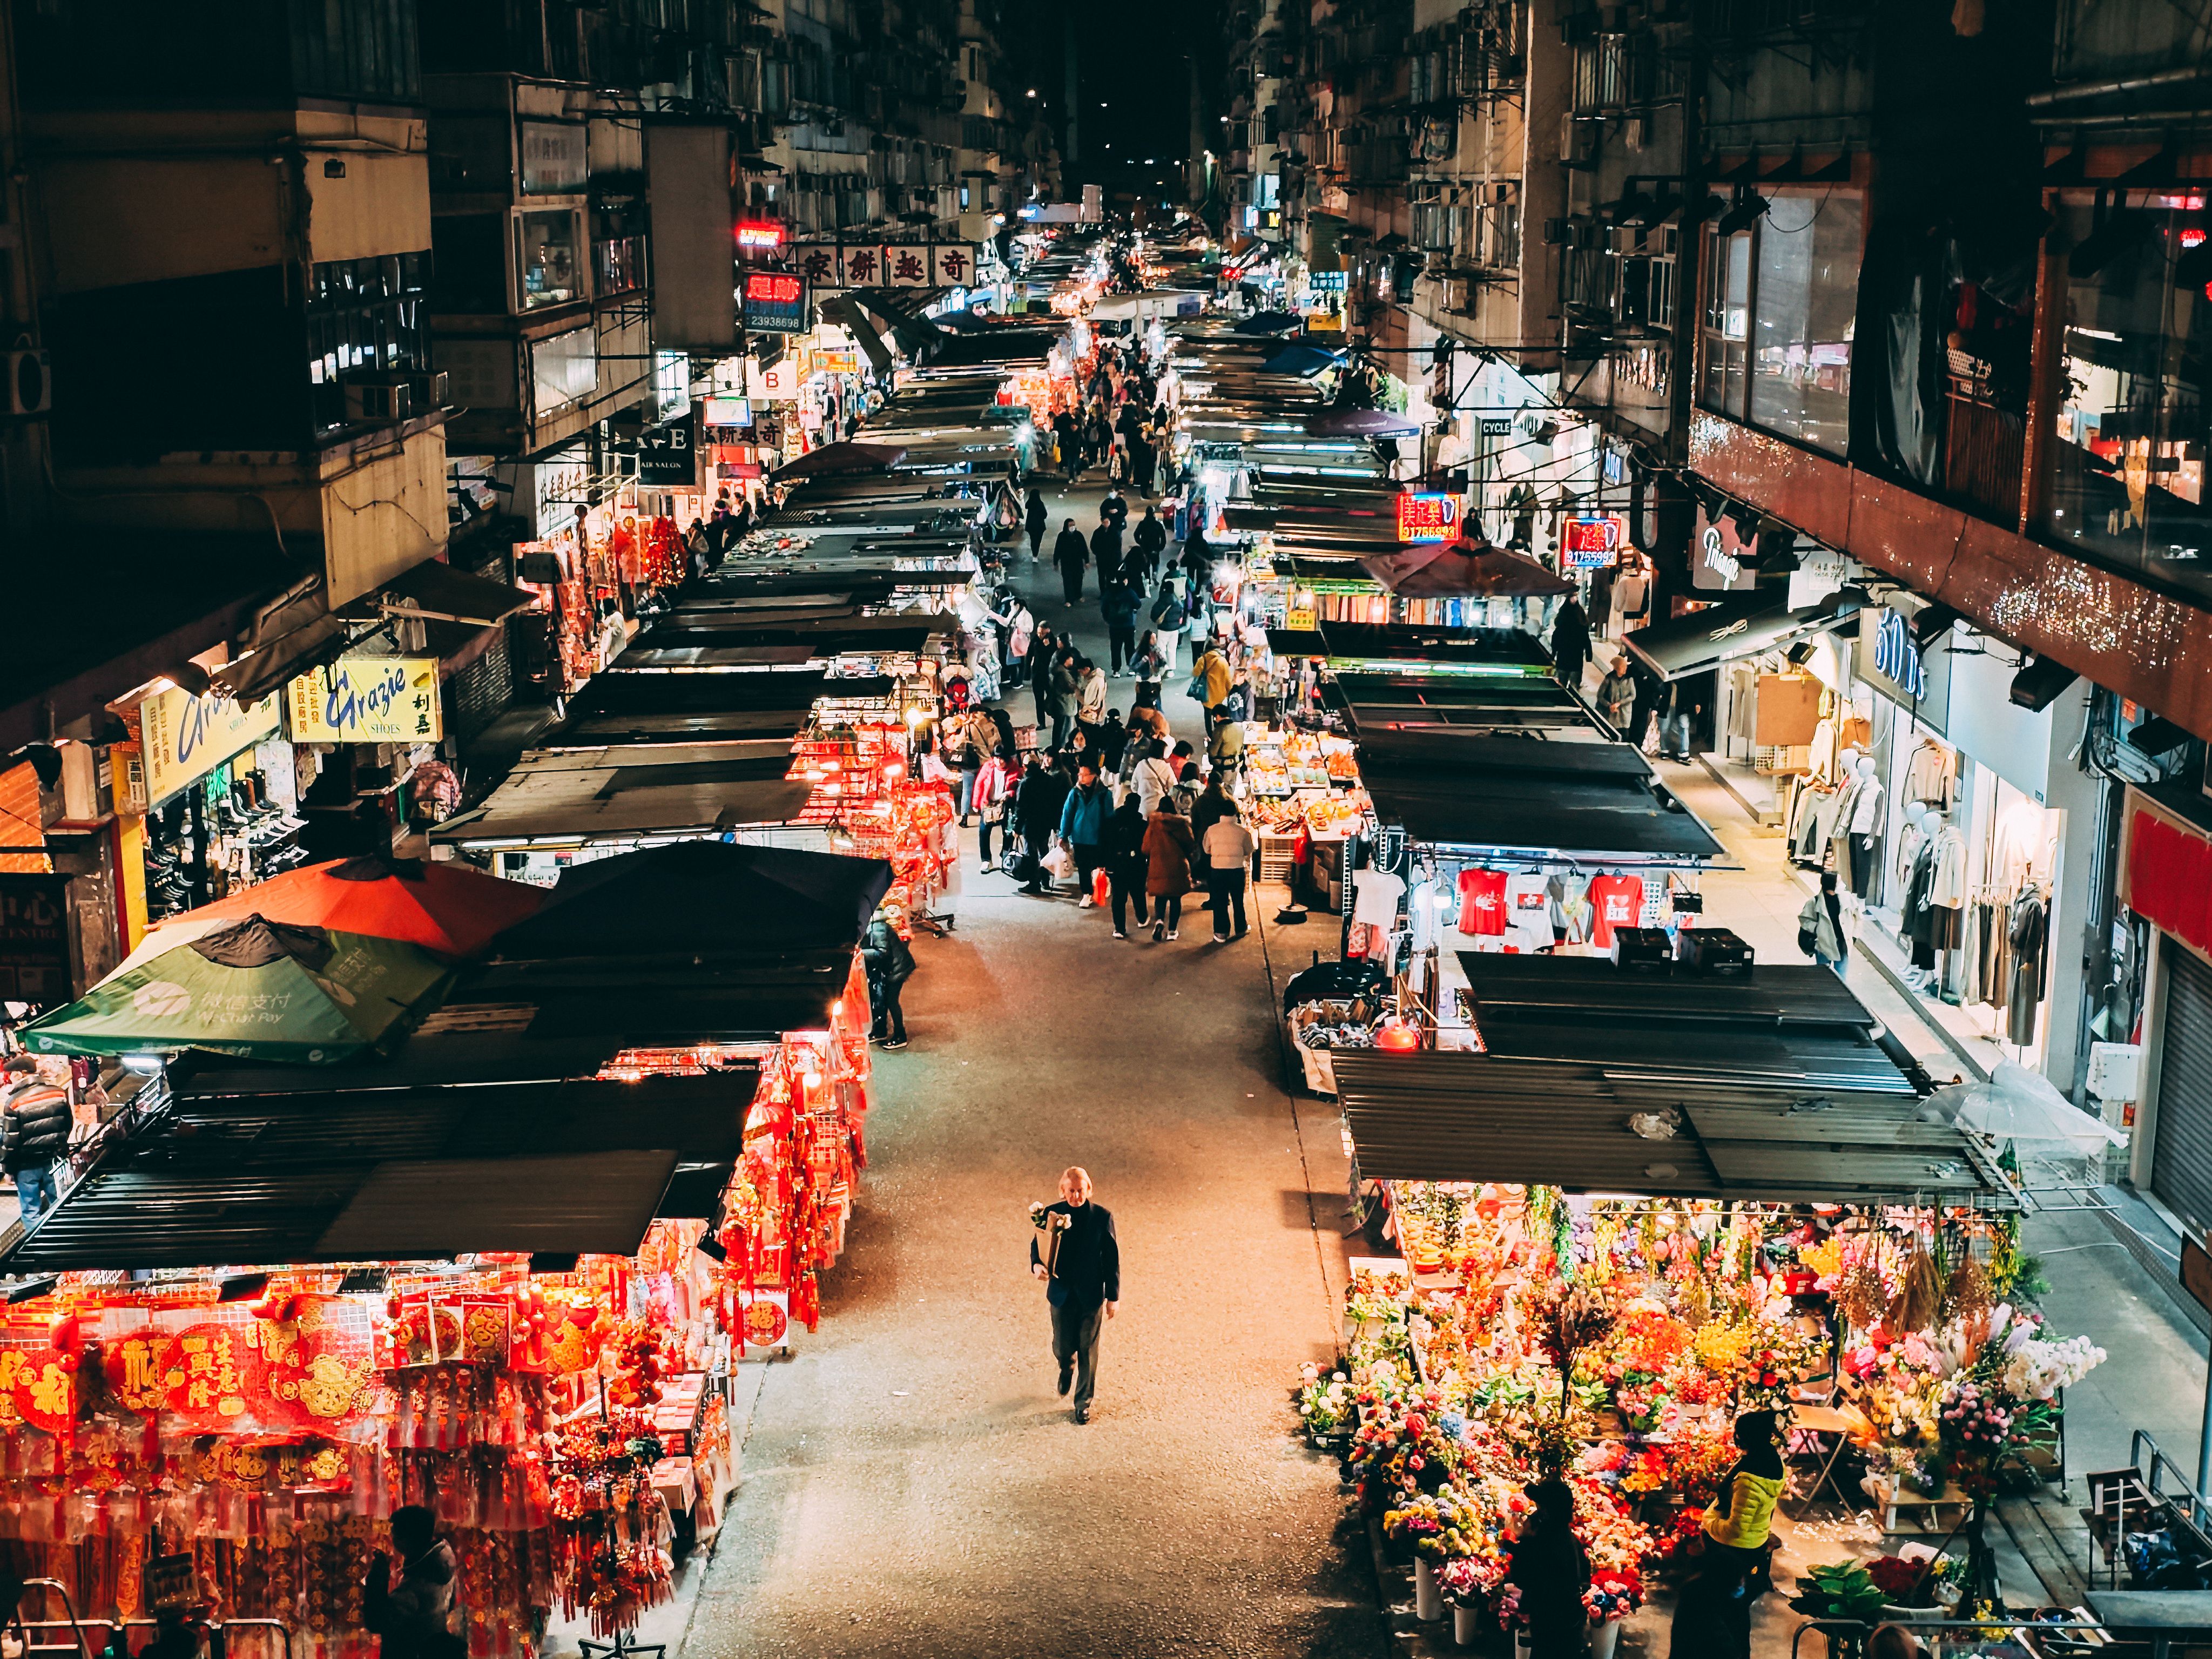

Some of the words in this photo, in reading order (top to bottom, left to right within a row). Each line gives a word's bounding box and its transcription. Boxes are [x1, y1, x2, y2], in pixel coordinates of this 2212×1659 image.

[766, 372, 779, 388] B
[1483, 423, 1510, 433] CYCLE
[1567, 551, 1615, 563] 91755993
[326, 668, 406, 730] Grazie
[370, 724, 401, 734] SHOES
[1606, 907, 1629, 921] HK
[0, 928, 59, 939] ENTRE
